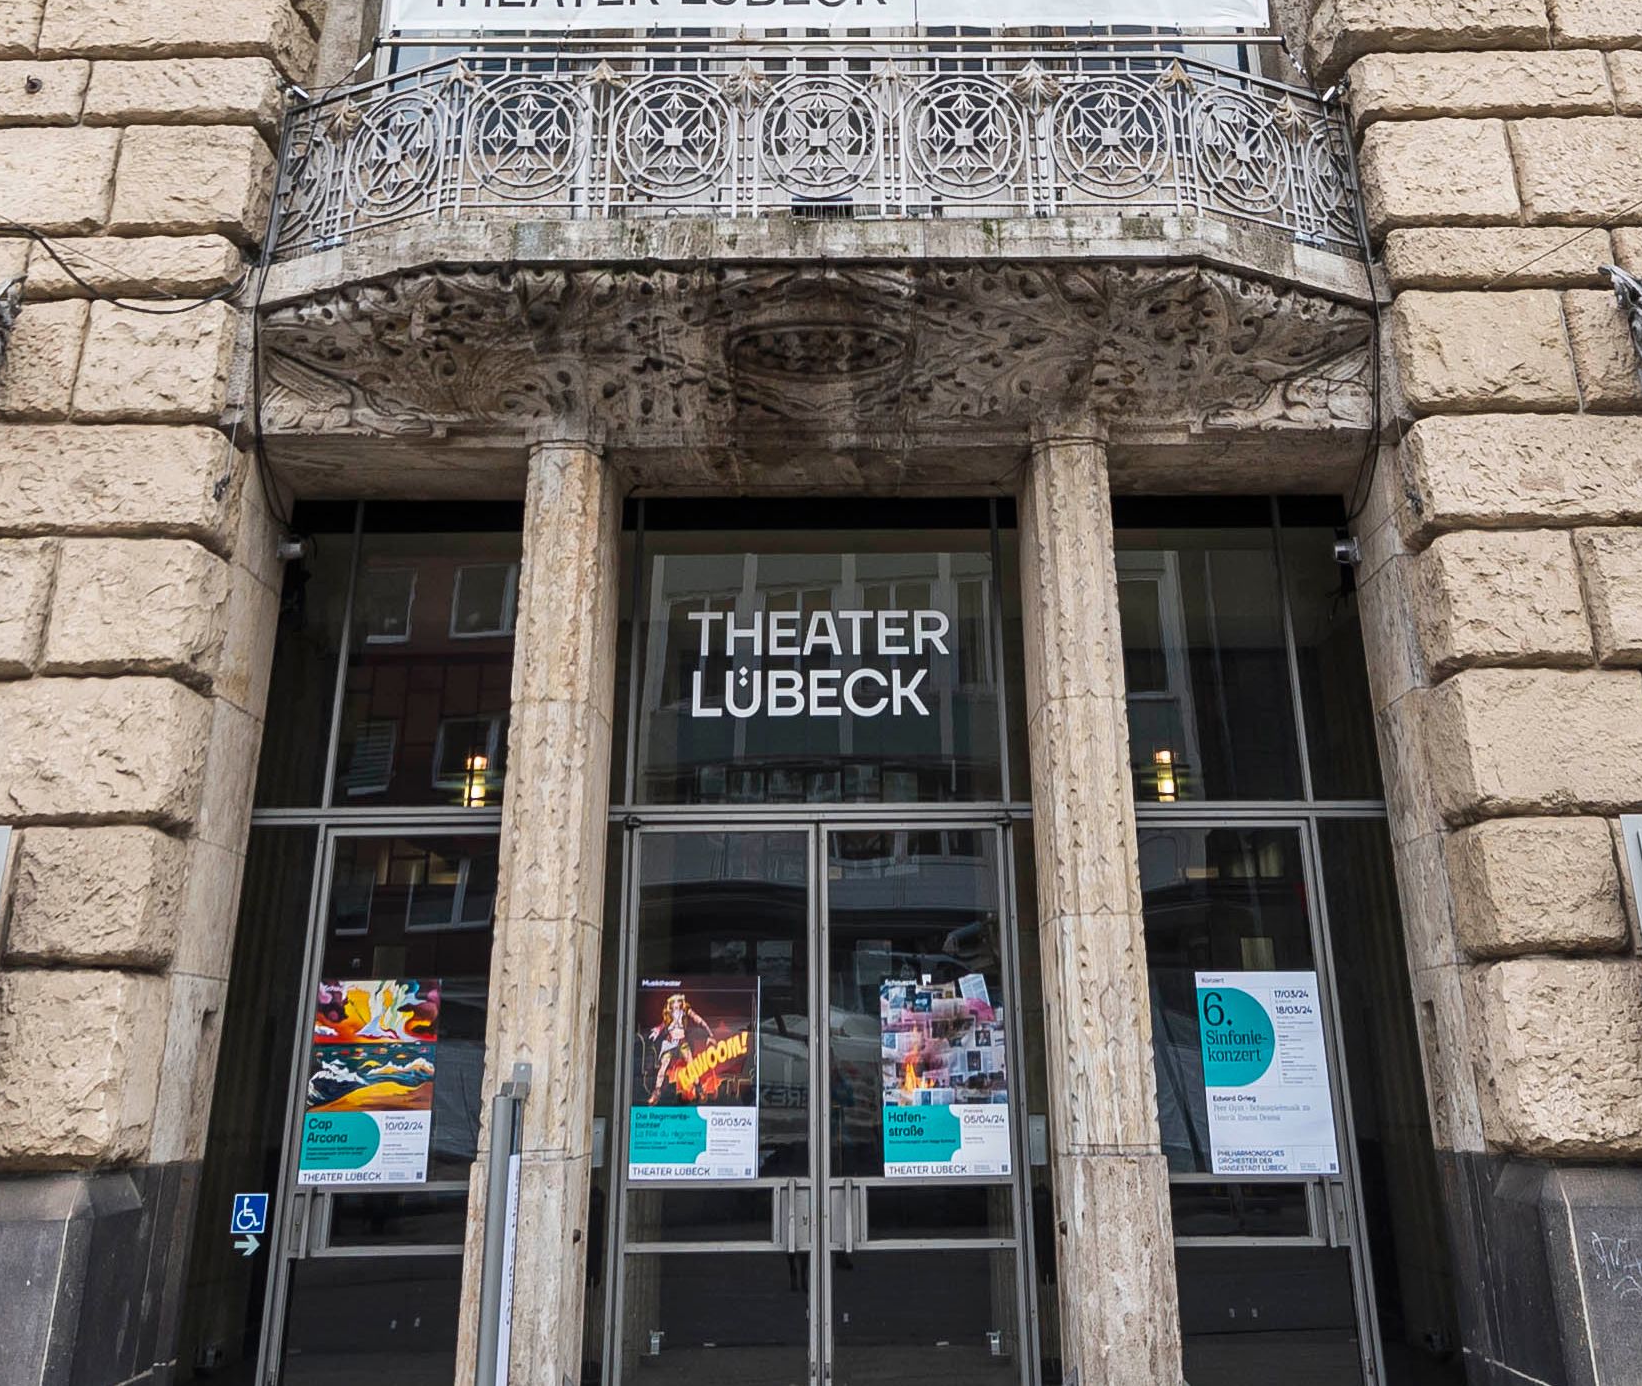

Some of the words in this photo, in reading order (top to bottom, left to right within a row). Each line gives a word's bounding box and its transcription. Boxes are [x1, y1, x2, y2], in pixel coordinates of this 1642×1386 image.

[687, 610, 950, 657] THEATER
[691, 666, 930, 718] LÜBECK
[1274, 990, 1309, 999] 17/03/24
[1276, 1005, 1313, 1015] 18/03/24
[1205, 1030, 1269, 1045] Sinfonie-
[1208, 1046, 1262, 1062] konzert
[710, 1118, 752, 1127] 08/03/24
[963, 1114, 1005, 1124] 05/04/24
[308, 1118, 333, 1131] Cap
[384, 1121, 424, 1131] 10/02/24
[888, 1125, 924, 1137] straße
[307, 1132, 348, 1143] Arcona
[633, 1167, 672, 1175] THEATER
[889, 1166, 929, 1175] THEATER
[303, 1172, 343, 1182] THEATER
